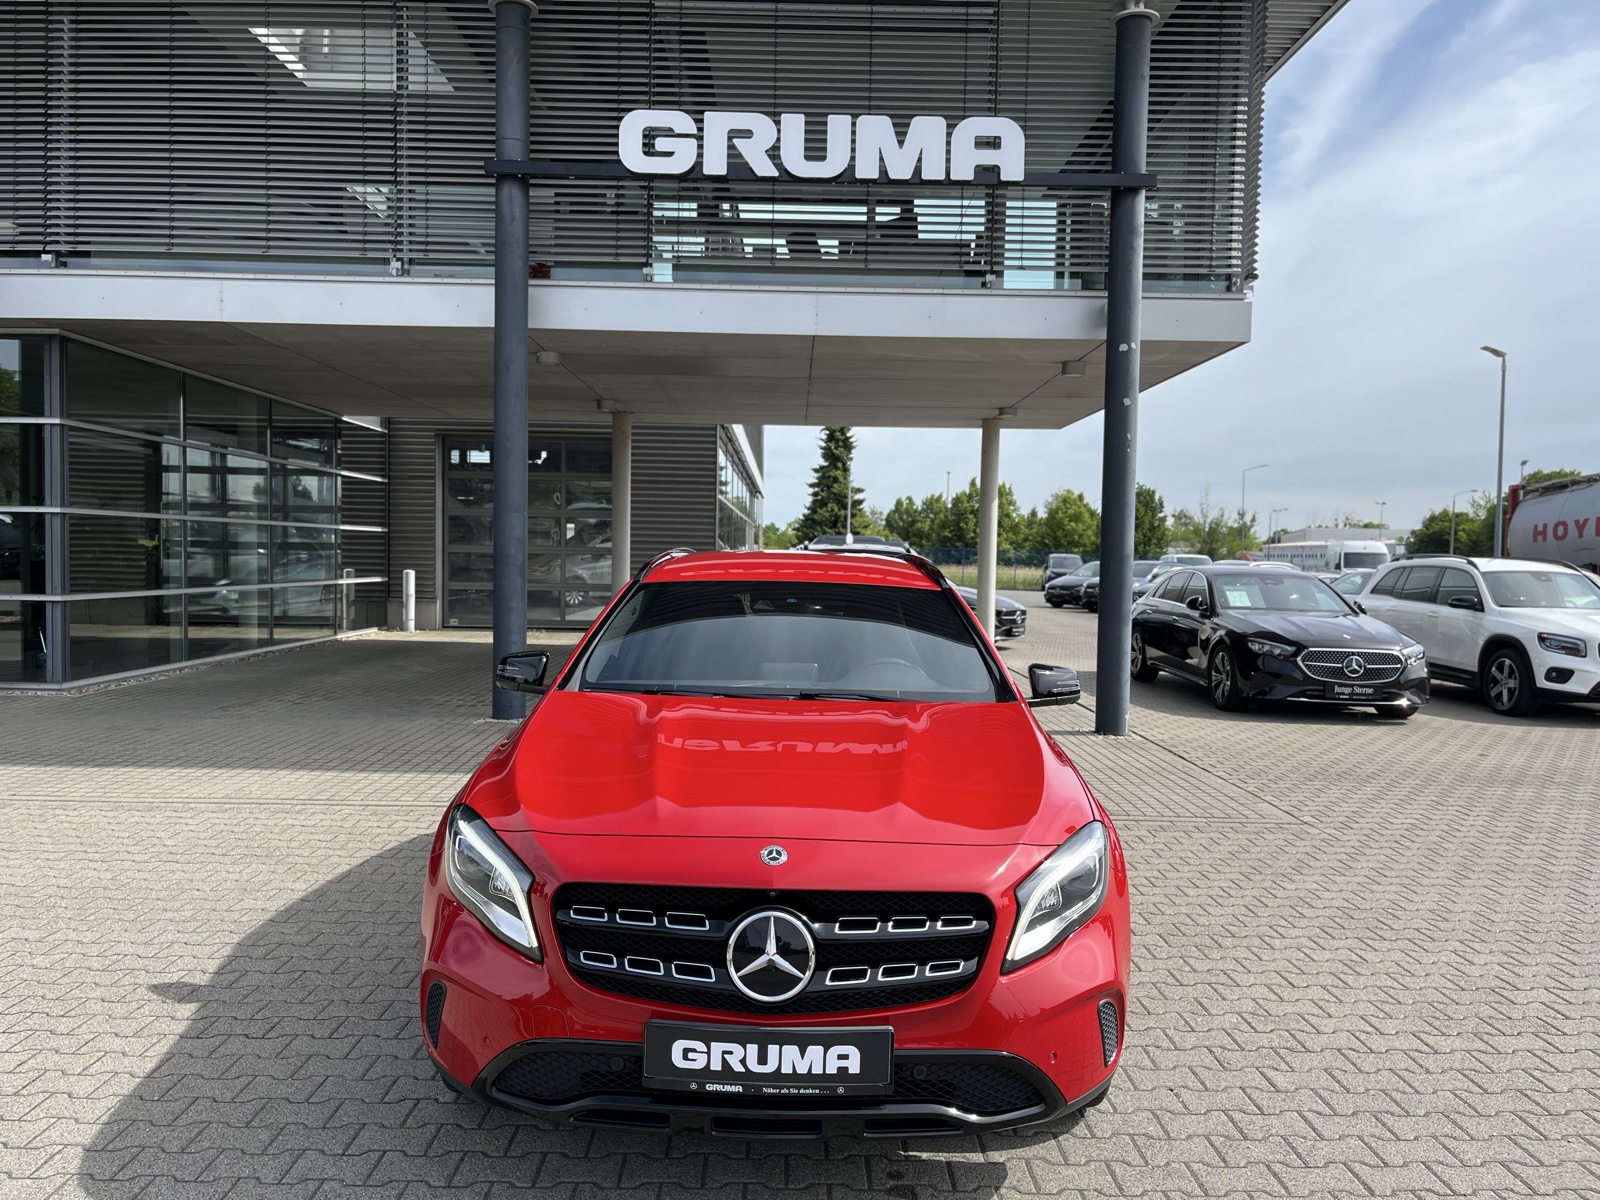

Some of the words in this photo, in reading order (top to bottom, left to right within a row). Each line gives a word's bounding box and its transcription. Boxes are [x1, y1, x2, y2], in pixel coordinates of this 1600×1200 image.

[618, 109, 1025, 181] GRUMA
[1334, 685, 1353, 694] Junge
[1353, 686, 1374, 694] Sterne
[671, 1039, 861, 1074] GRUMA
[705, 1083, 743, 1092] GRUMA
